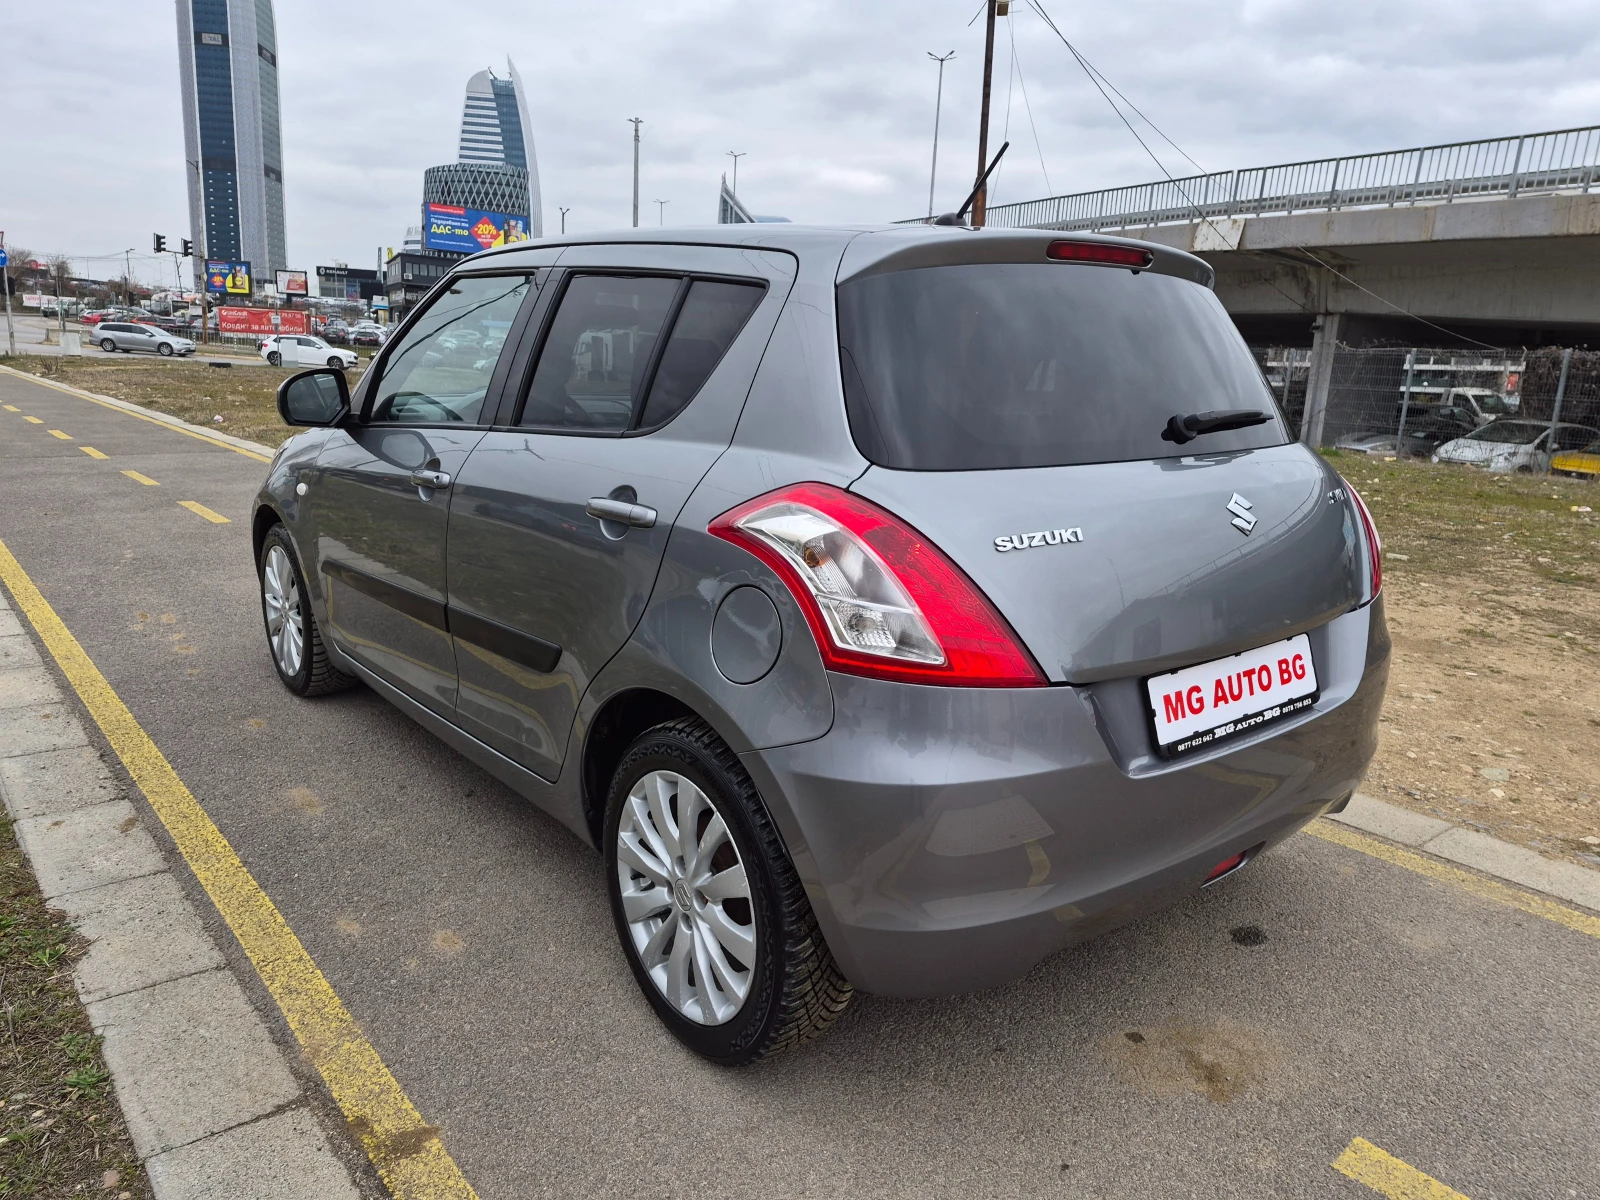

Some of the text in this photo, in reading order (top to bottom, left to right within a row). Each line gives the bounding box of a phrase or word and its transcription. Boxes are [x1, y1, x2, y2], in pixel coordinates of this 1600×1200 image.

[474, 224, 497, 235] -20%
[222, 321, 249, 330] Кредит
[994, 526, 1084, 552] SUZUKI
[1163, 653, 1306, 723] MG AUTO BG
[1177, 741, 1191, 751] 0877
[1192, 737, 1203, 747] 622
[1214, 723, 1236, 738] MG
[1235, 715, 1264, 731] AUTO
[1263, 706, 1281, 720] BG
